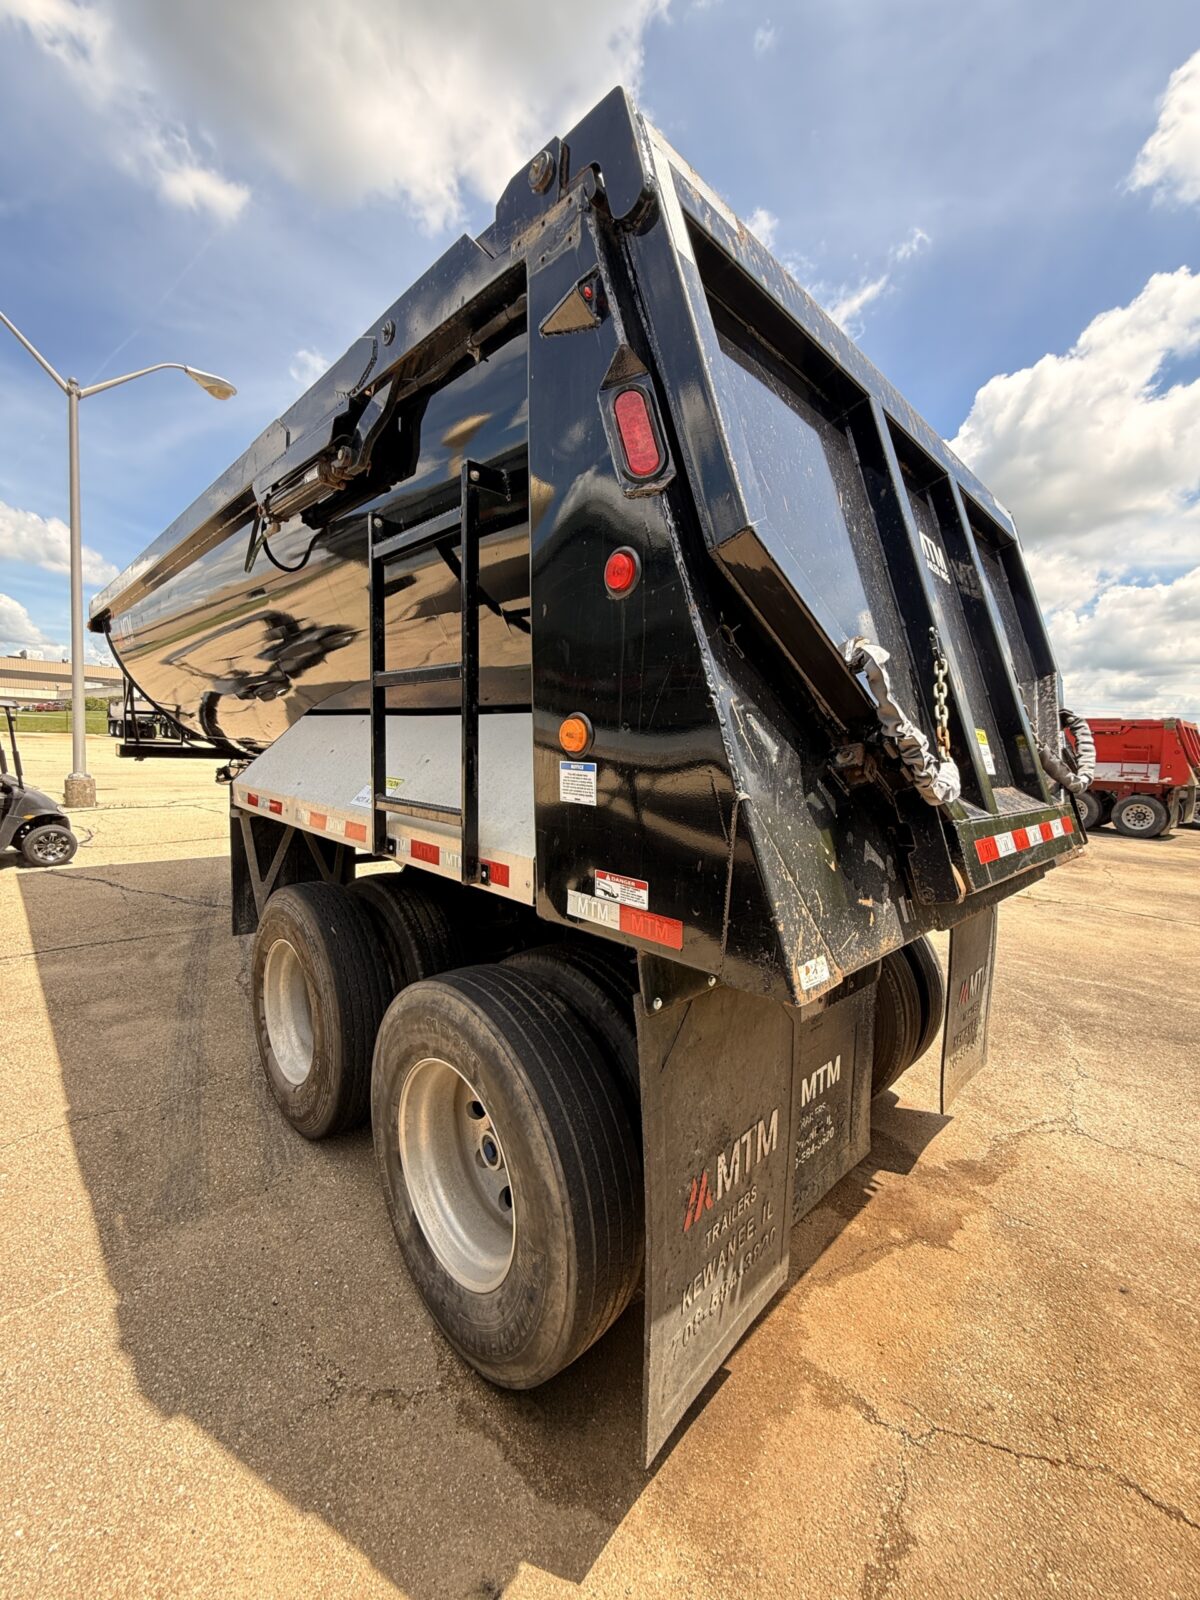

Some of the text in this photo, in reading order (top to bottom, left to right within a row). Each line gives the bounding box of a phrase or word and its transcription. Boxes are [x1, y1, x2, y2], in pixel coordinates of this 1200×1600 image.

[611, 876, 636, 886] DANGER
[577, 896, 609, 921] MTM
[631, 913, 669, 940] MTM
[801, 1054, 841, 1108] MTM
[716, 1108, 779, 1201] MTM
[705, 1185, 757, 1249] TRAILERS
[762, 1201, 774, 1225] IL
